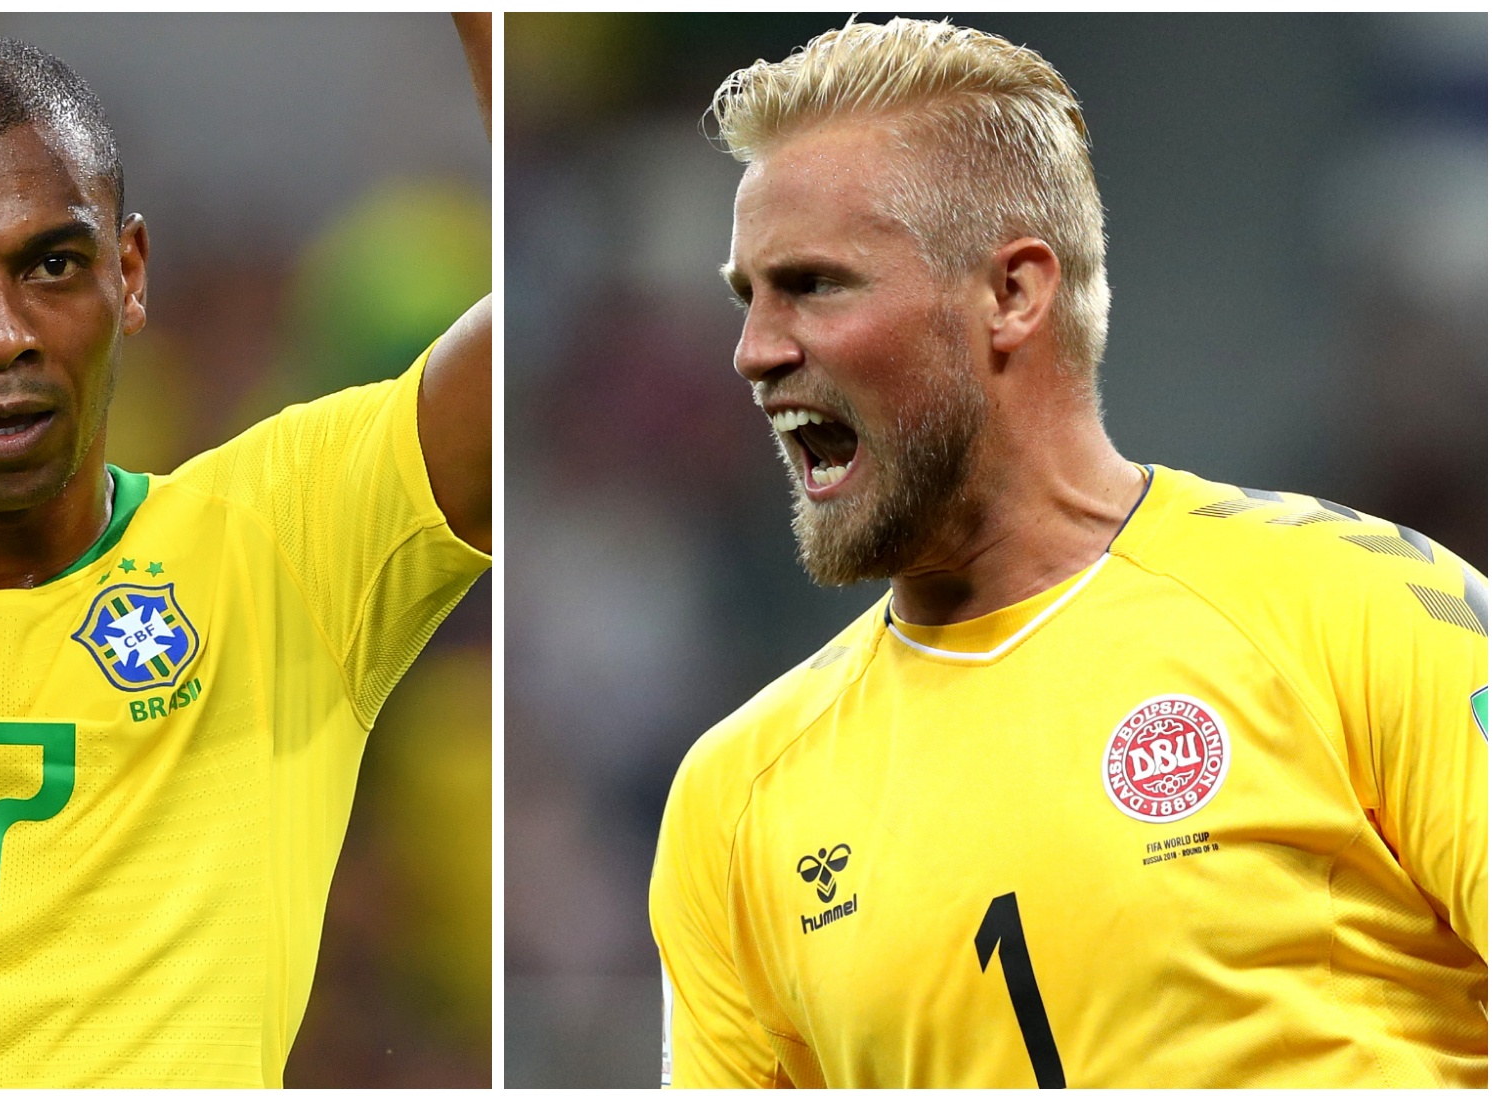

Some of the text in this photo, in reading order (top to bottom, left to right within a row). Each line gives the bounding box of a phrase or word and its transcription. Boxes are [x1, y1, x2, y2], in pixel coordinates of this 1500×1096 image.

[124, 623, 155, 648] CBF
[1128, 731, 1202, 782] DBU
[1109, 742, 1145, 811] DANSK
[1150, 791, 1199, 816] 1889
[1142, 855, 1163, 866] RUSSIA
[1163, 851, 1177, 861] 2018
[1182, 846, 1202, 857] ROUND
[1202, 844, 1211, 853] OF
[1211, 842, 1219, 852] 16
[1146, 831, 1210, 854] FIFA WORLD CUP
[800, 893, 857, 934] hummel
[974, 892, 1067, 1089] 1
